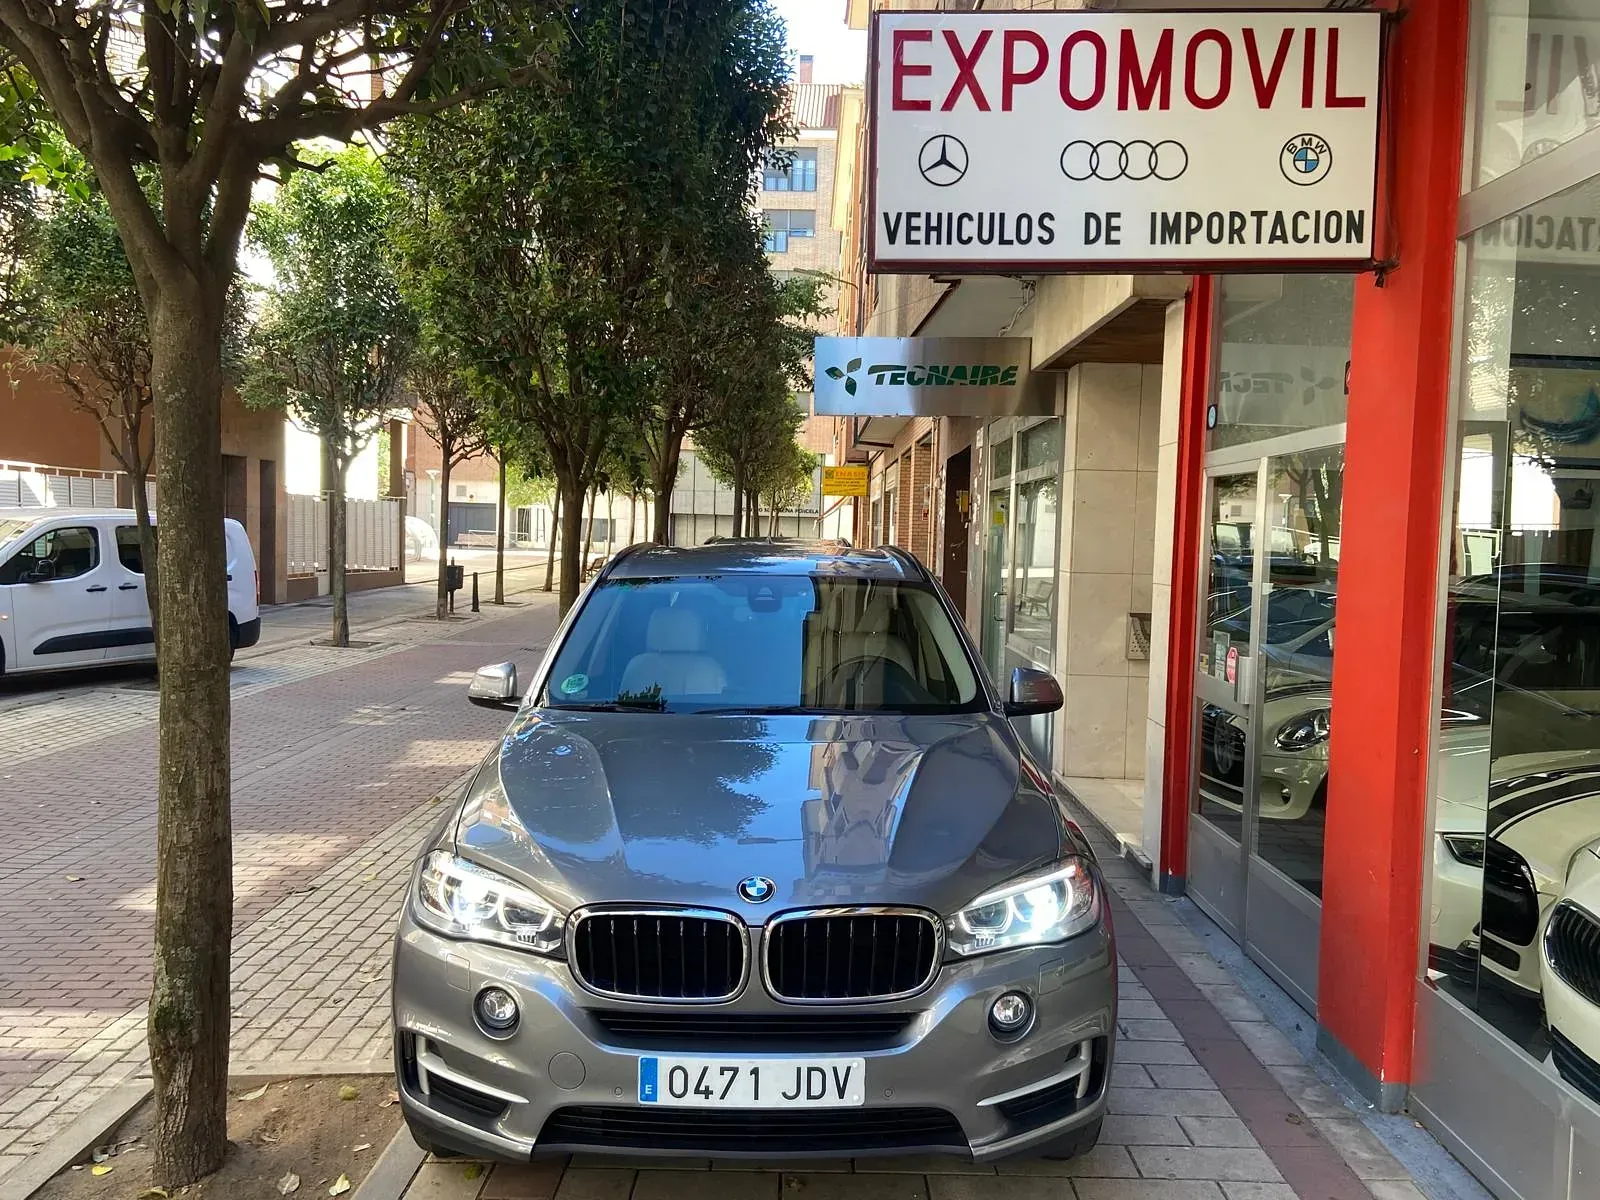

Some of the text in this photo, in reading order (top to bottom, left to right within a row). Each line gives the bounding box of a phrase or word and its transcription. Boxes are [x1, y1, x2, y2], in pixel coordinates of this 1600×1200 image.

[892, 27, 1366, 112] EXPOMOVIL
[1286, 137, 1327, 155] BMW
[882, 209, 1366, 246] VEHICULOS DE IMPORTACION
[867, 364, 1019, 386] TECNAIRE
[645, 1084, 653, 1095] E
[668, 1064, 852, 1101] 0471 JDV
